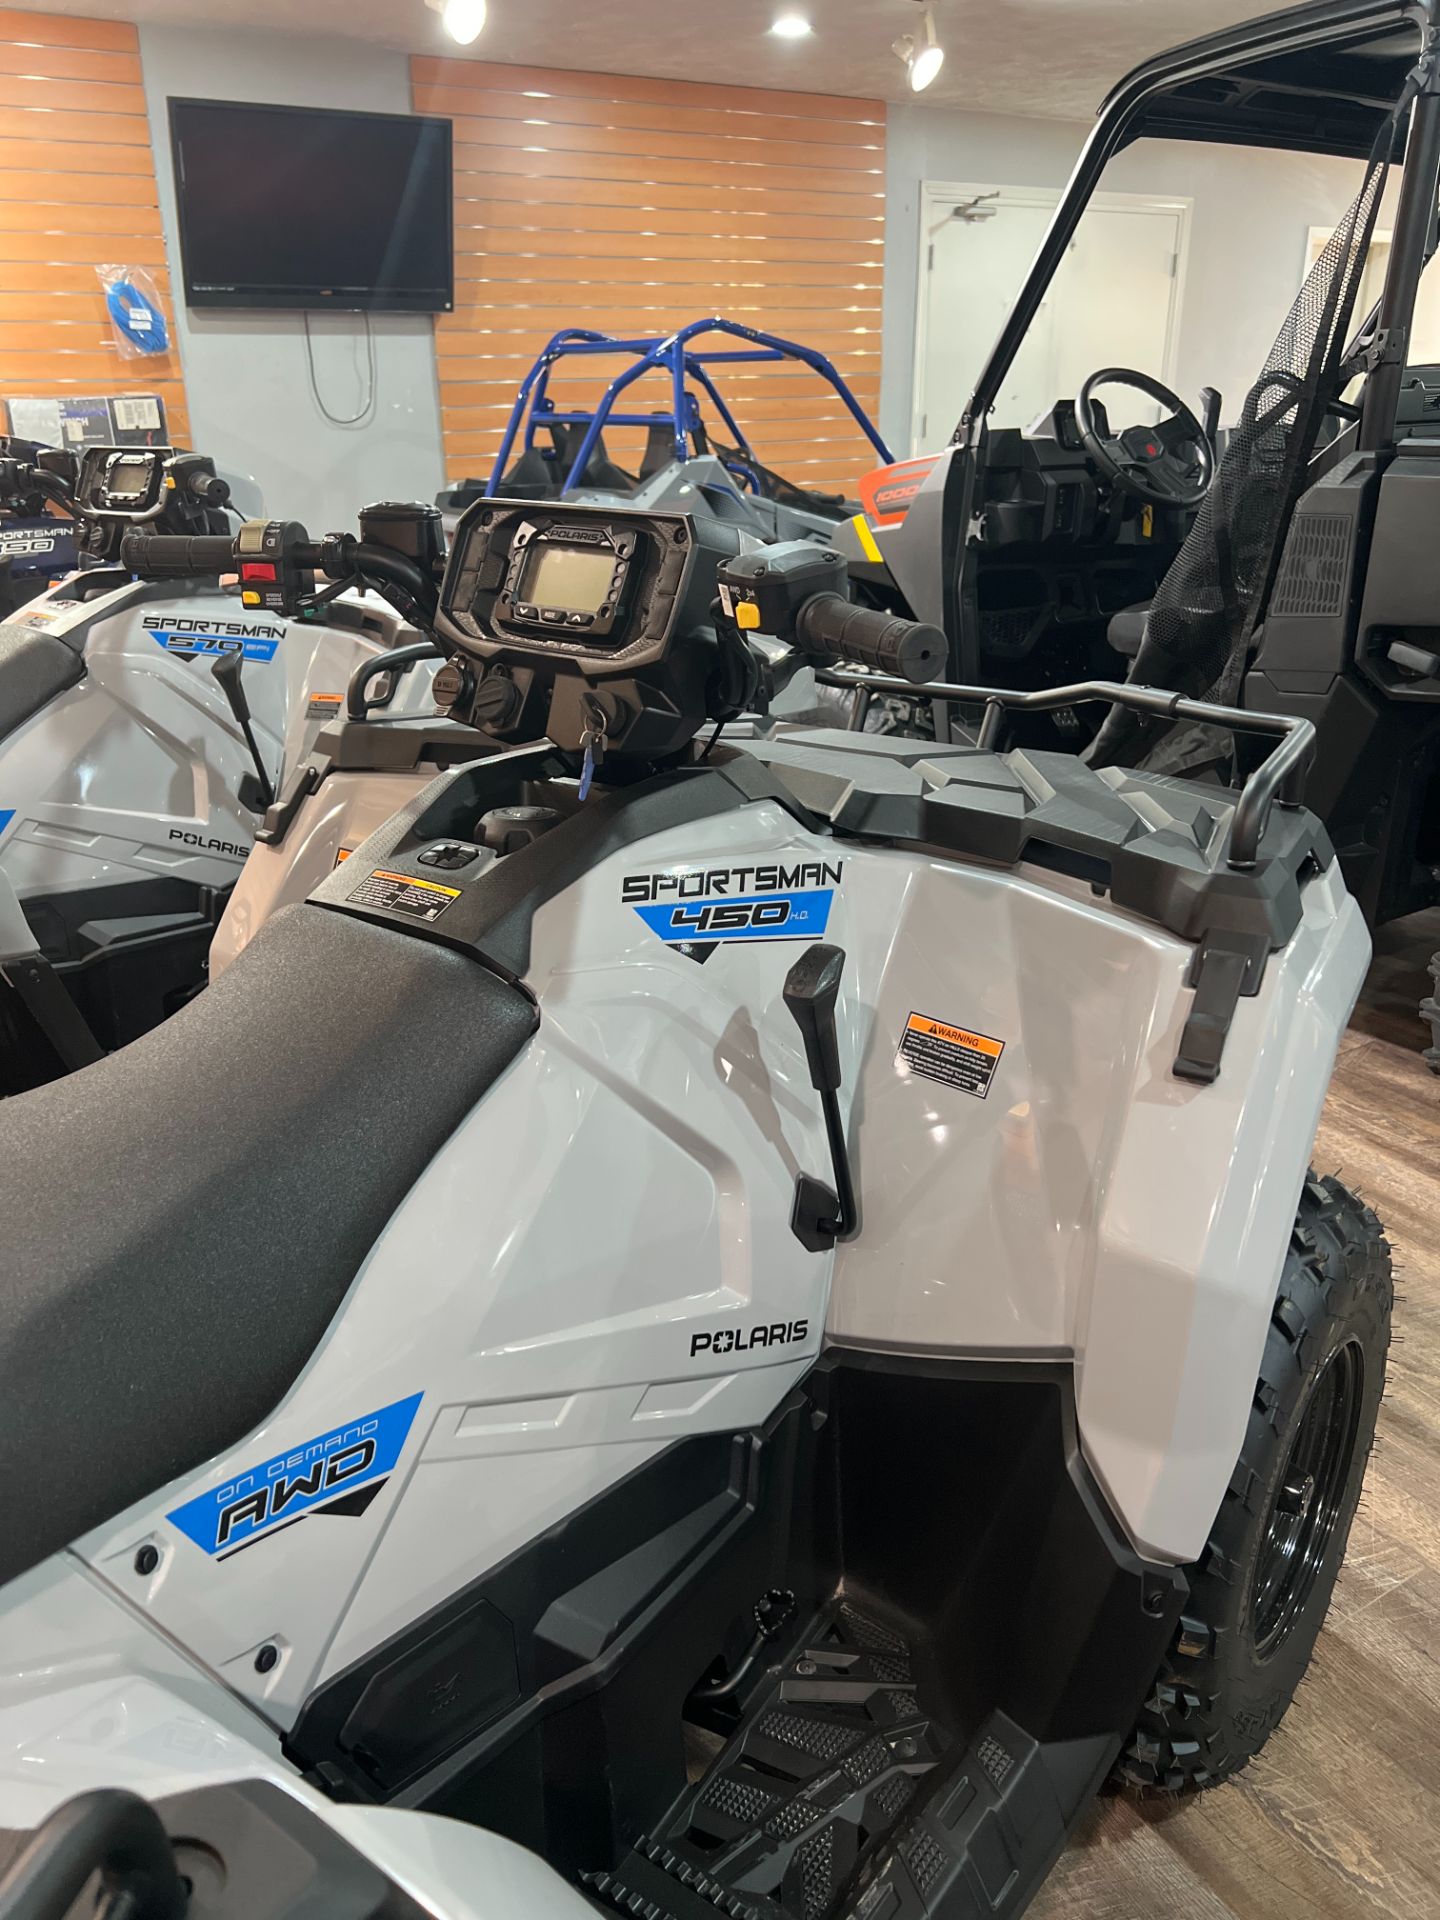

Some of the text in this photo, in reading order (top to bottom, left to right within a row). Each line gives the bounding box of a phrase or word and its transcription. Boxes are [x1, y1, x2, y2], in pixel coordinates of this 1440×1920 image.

[0, 527, 73, 540] ORTSMAN
[550, 529, 600, 541] POLARIS
[142, 616, 287, 639] SPORTSMAN
[167, 636, 244, 652] 570
[168, 828, 250, 858] POLARIS
[621, 860, 843, 903] SPORTSMAN
[669, 899, 791, 933] 450
[938, 1026, 980, 1048] WARNING
[690, 1319, 809, 1357] POLARIS
[216, 1419, 379, 1504] ON DEMAND
[215, 1437, 377, 1548] AWD
